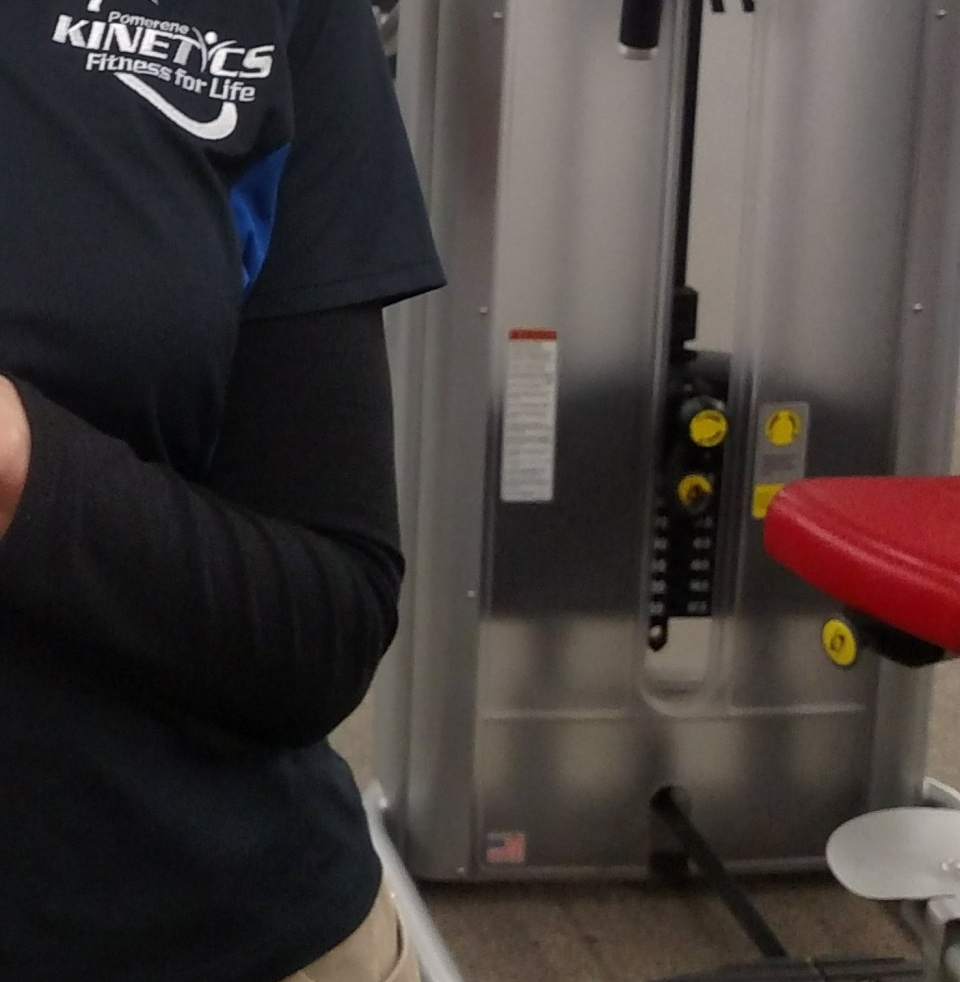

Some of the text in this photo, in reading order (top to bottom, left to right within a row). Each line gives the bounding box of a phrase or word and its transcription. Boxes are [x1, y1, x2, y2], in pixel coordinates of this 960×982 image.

[107, 11, 190, 35] Pomerene
[85, 52, 256, 102] Fitness for Life
